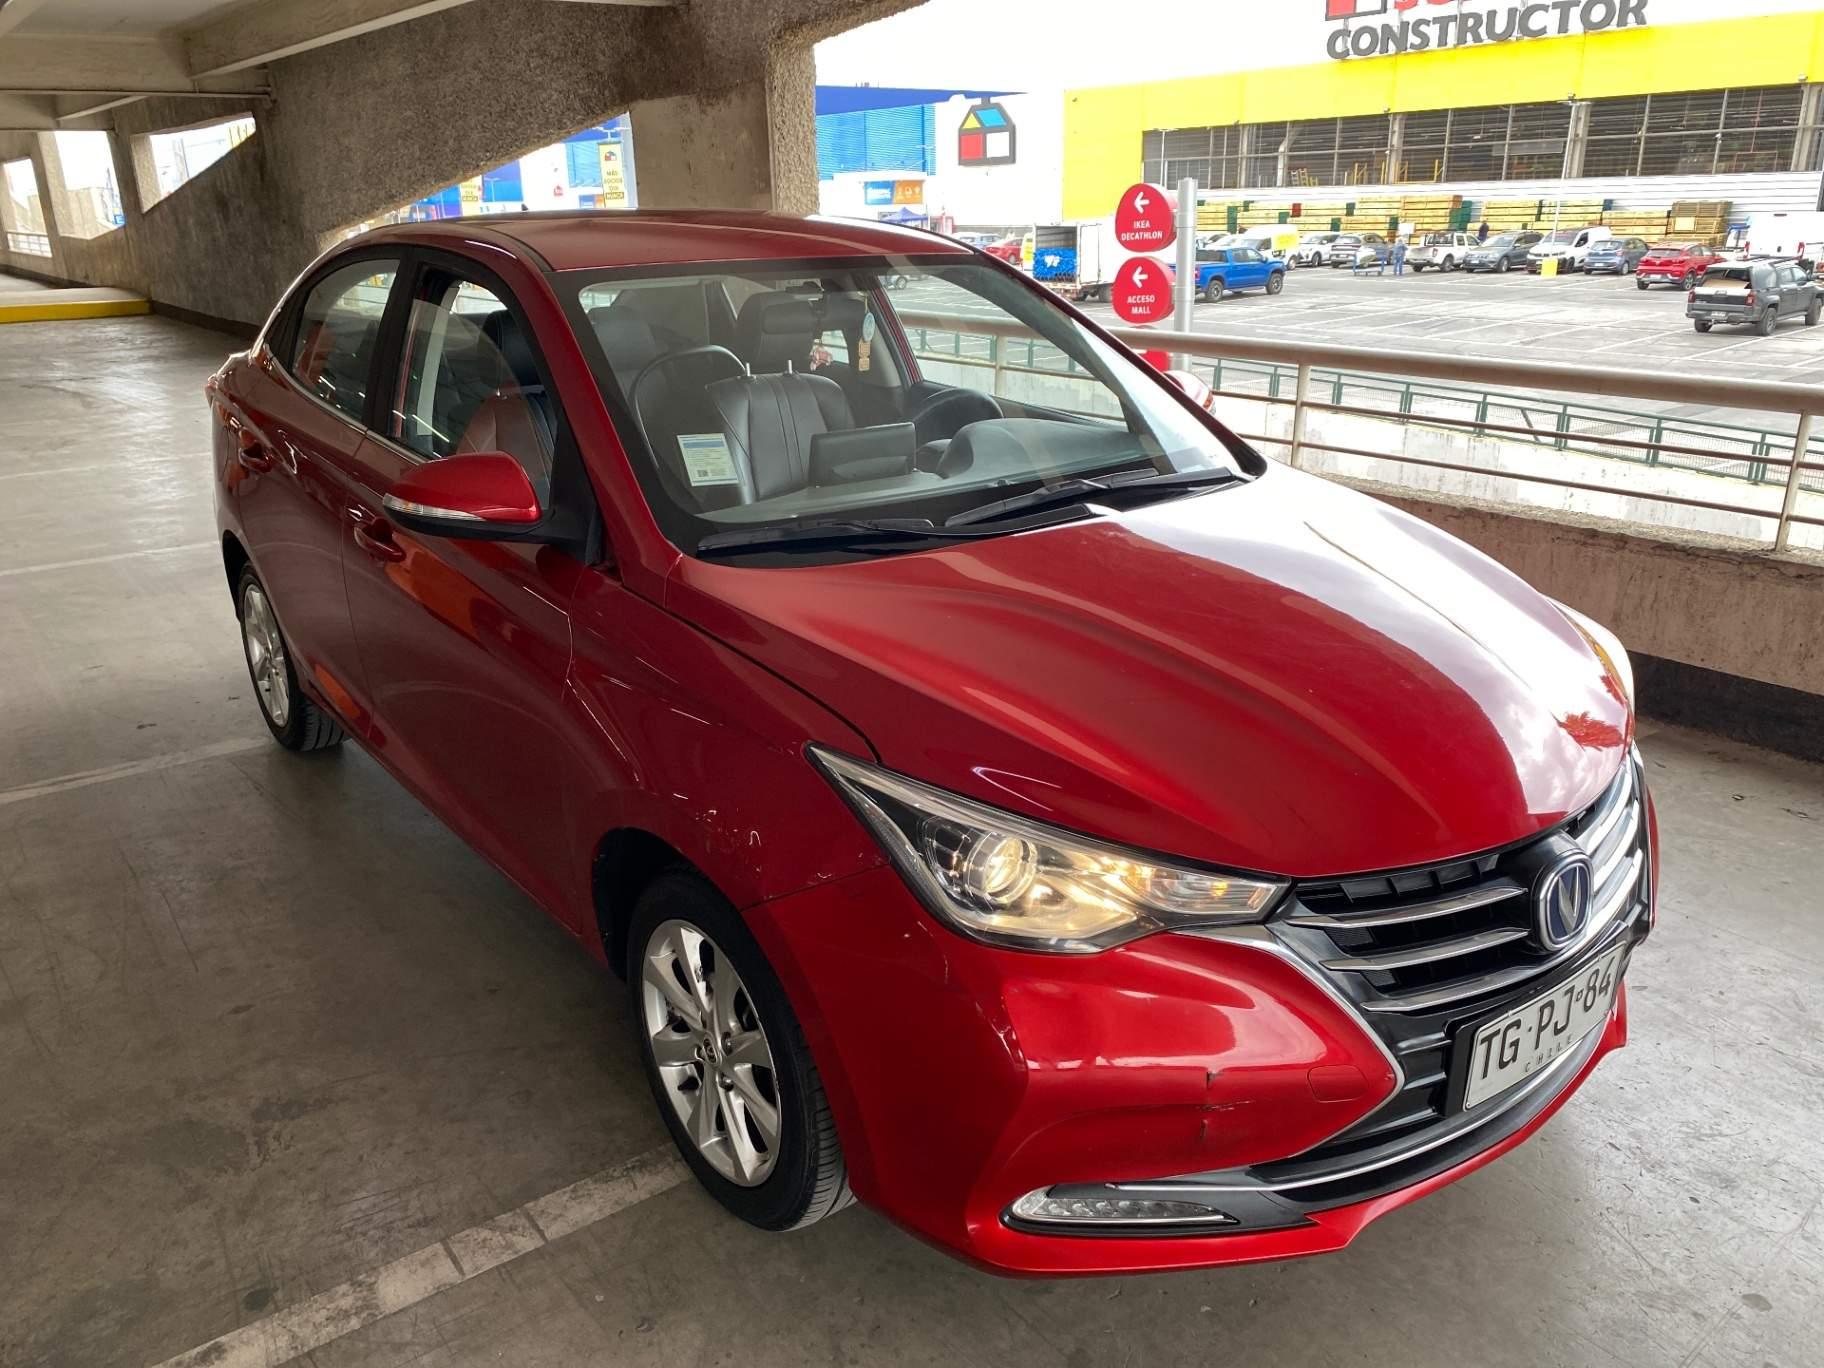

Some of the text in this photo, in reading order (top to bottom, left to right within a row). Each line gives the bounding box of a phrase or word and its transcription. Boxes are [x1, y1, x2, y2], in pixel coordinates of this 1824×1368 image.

[1326, 0, 1648, 60] CONSTRUCTOR
[1133, 219, 1151, 228] IKEA
[1121, 230, 1163, 241] DECATHLON
[1127, 295, 1155, 304] ACCESO
[1131, 305, 1151, 314] MALL
